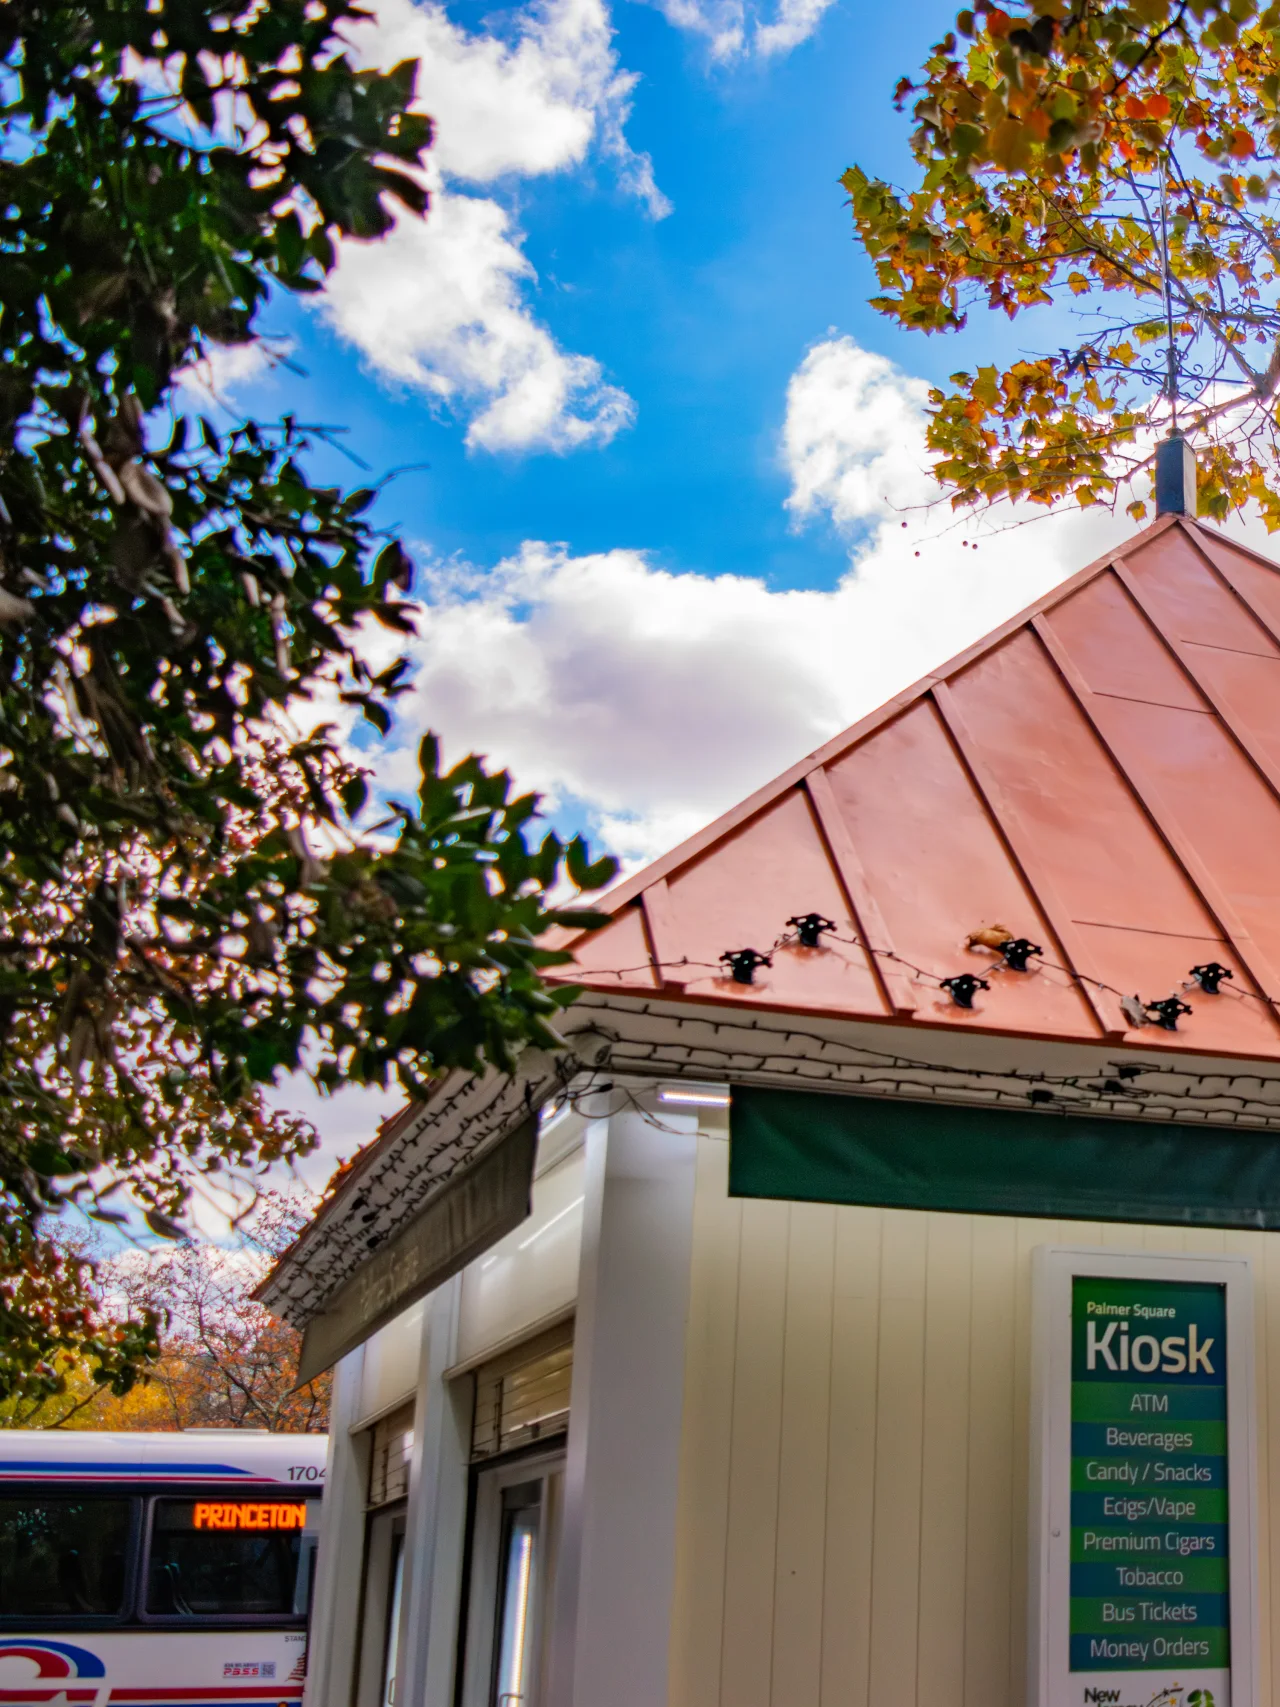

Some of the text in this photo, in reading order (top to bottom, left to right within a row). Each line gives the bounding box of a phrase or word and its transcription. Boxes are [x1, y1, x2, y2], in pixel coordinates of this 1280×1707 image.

[1087, 1301, 1176, 1320] Palmer Square
[1086, 1320, 1216, 1375] Kiosk
[1130, 1394, 1168, 1413] ATM
[1106, 1427, 1193, 1452] Beverages
[1086, 1461, 1138, 1485] Candy
[1154, 1462, 1212, 1481] Snacks
[194, 1502, 307, 1530] PRINCETON
[1104, 1497, 1196, 1521] Ecigs/Vape
[1084, 1531, 1215, 1556] Premium Cigars
[1116, 1566, 1184, 1586] Tobacco
[1102, 1601, 1198, 1622] Bus Tickets
[1090, 1636, 1209, 1661] Money Orders
[1084, 1687, 1121, 1704] New
